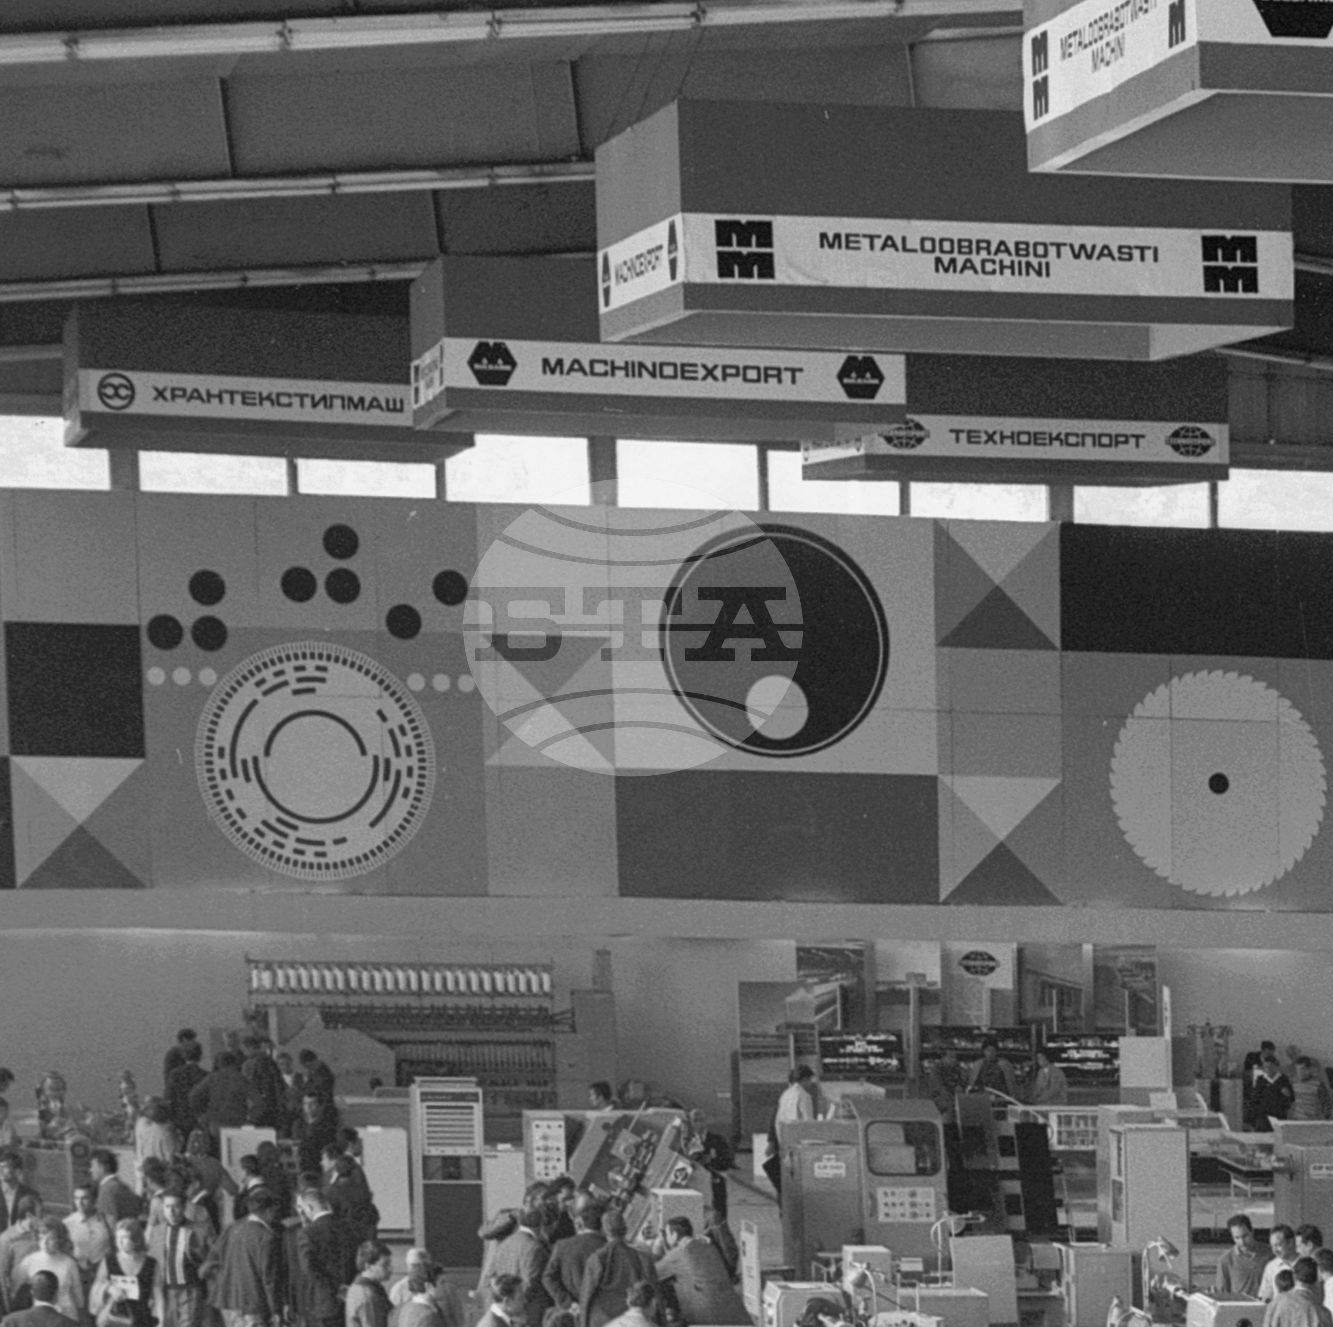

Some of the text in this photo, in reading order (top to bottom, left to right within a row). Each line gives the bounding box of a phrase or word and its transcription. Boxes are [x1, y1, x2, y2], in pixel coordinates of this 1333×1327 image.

[818, 231, 1160, 264] METALOOBRABOTWASTI
[933, 256, 1051, 279] MACHINI
[541, 356, 804, 386] MACHINOEXPORT
[948, 428, 1146, 450] ТЕХНОЕКСПОРТ
